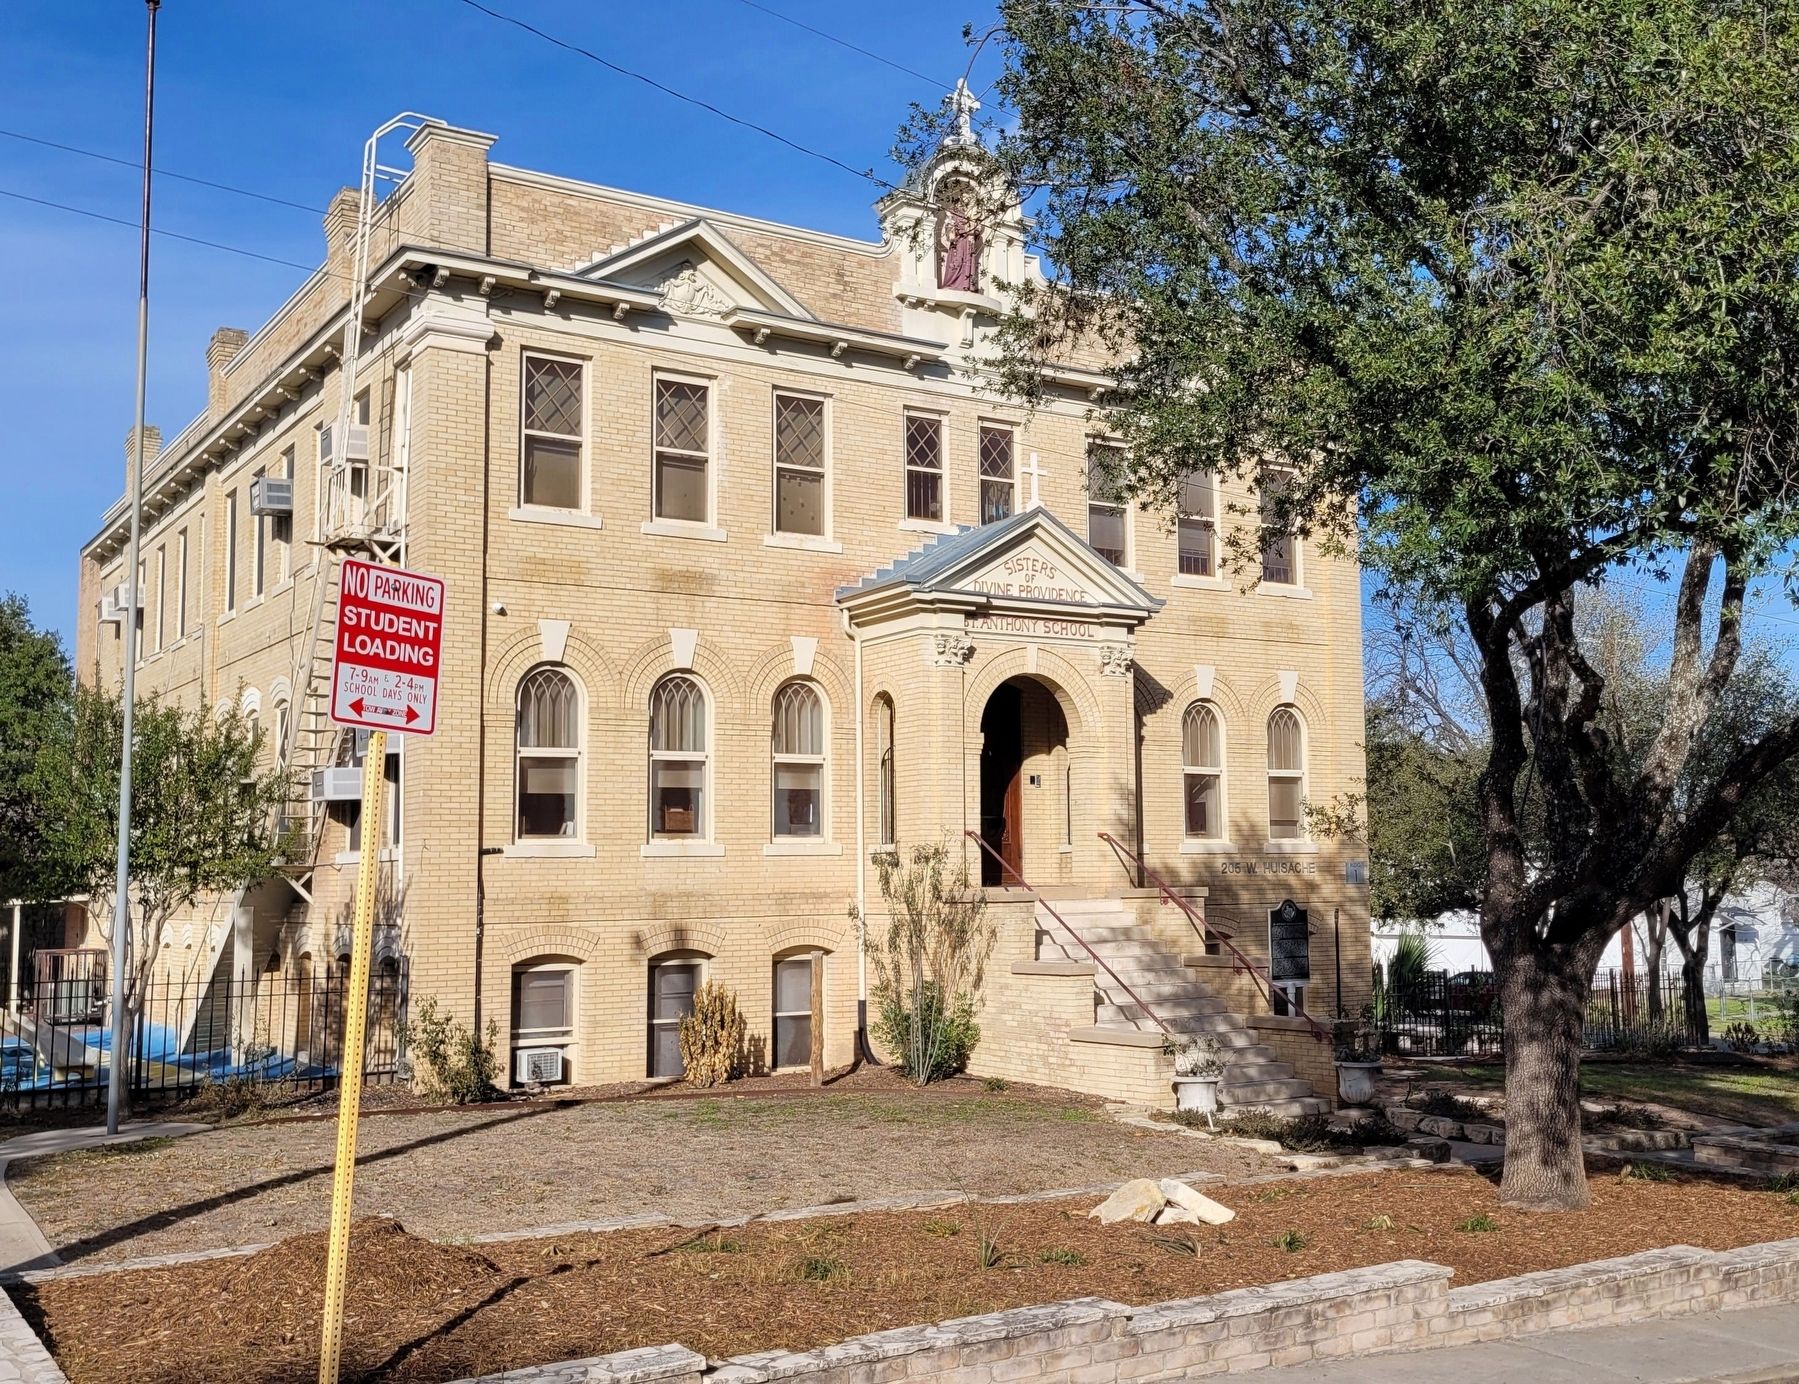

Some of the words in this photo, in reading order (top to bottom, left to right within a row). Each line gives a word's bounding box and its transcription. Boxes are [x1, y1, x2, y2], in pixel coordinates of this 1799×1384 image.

[1004, 557, 1057, 579] SISTERS
[1025, 573, 1036, 583] OF
[344, 564, 368, 598] NO
[374, 575, 435, 608] PARKING
[974, 580, 1013, 596] DIVINE
[1018, 585, 1087, 602] PROVIDENCE
[343, 605, 438, 641] STUDENT
[980, 617, 1038, 632] ANTHONY
[1043, 621, 1095, 637] SCHOOL
[343, 632, 434, 666] LOADING
[344, 682, 377, 696] SCHOOL
[382, 688, 402, 700] DAYS
[407, 692, 427, 704] ONLY
[1221, 862, 1241, 874] 205
[1263, 862, 1316, 874] HUISACHE
